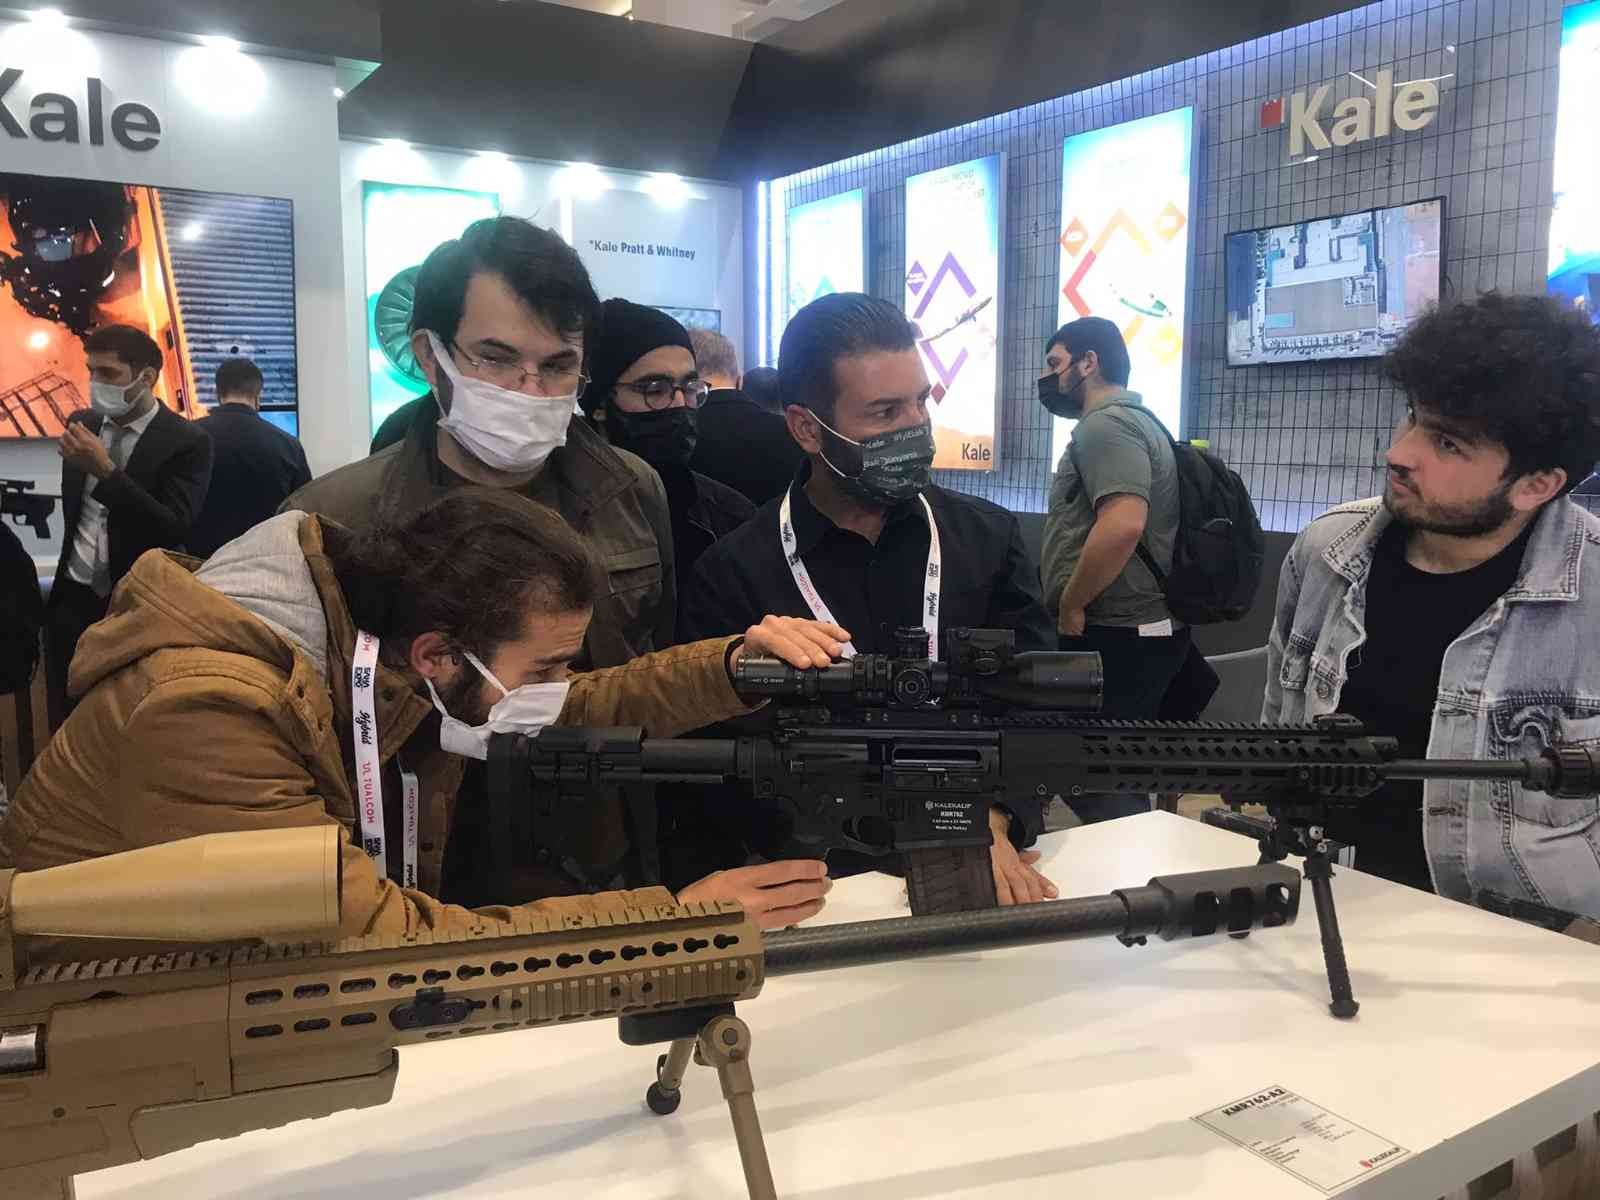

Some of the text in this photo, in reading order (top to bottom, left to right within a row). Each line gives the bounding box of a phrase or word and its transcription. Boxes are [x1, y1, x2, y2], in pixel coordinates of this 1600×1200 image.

[0, 68, 161, 151] Kale
[1289, 70, 1440, 156] Kale
[621, 242, 644, 254] Pratt
[647, 244, 654, 255] &
[656, 245, 696, 261] Whitney
[962, 443, 991, 461] Kale
[926, 592, 937, 617] Hybrid
[355, 710, 372, 745] Hybrid
[364, 779, 374, 823] TUALCOM
[1222, 1088, 1286, 1116] KMR762-A2
